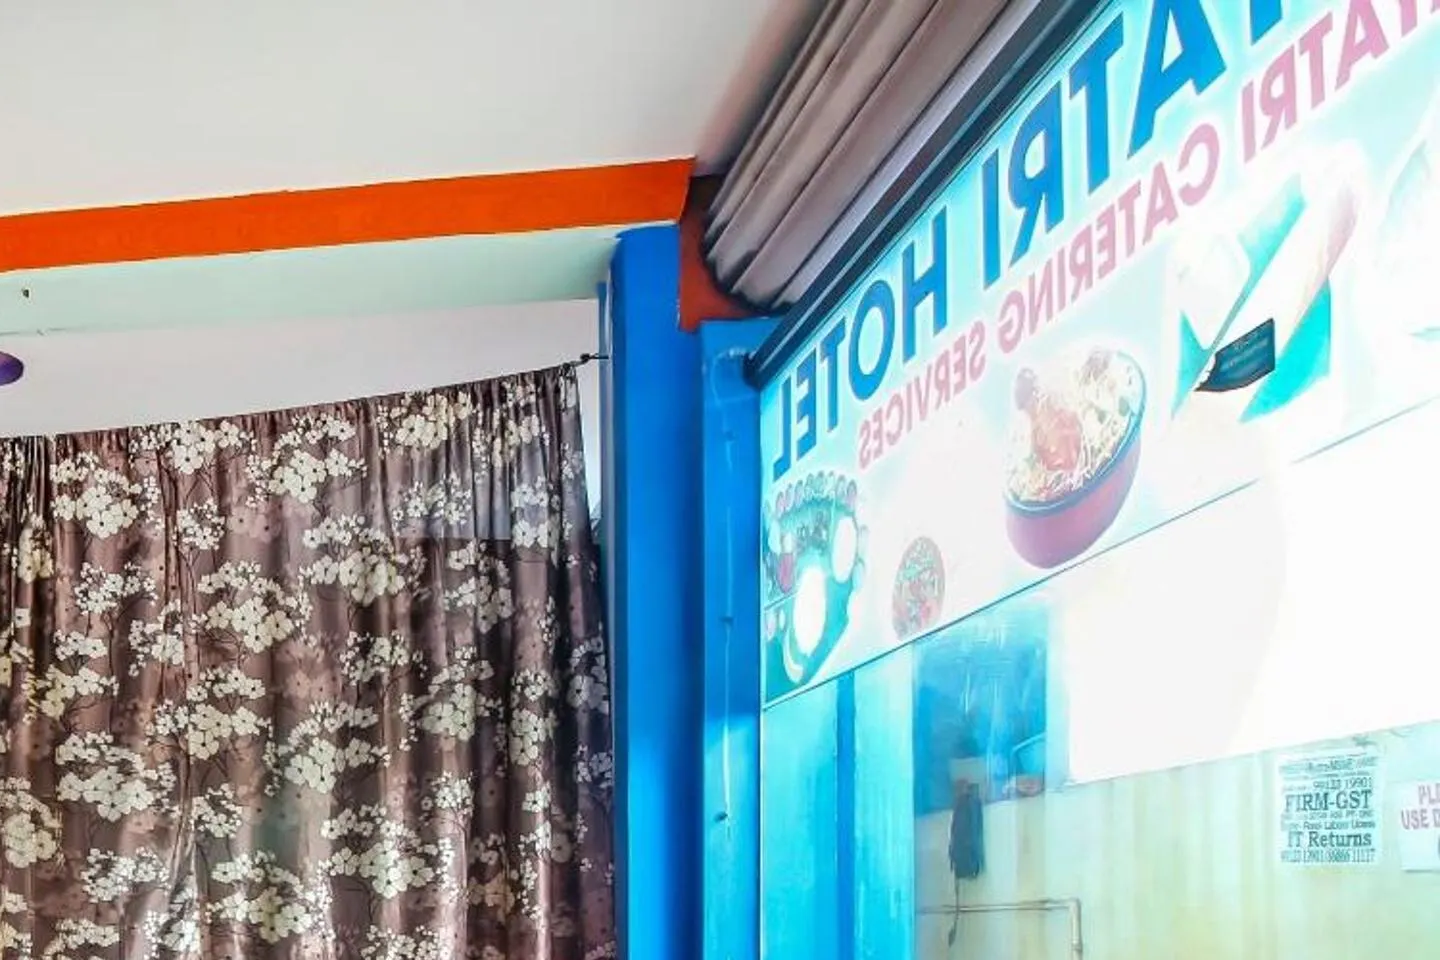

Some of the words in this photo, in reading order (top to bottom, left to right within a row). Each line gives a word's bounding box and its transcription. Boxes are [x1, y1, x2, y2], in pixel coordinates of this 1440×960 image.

[1285, 790, 1373, 813] FIRM-GST
[1401, 808, 1430, 830] USE
[1308, 830, 1372, 848] Returns
